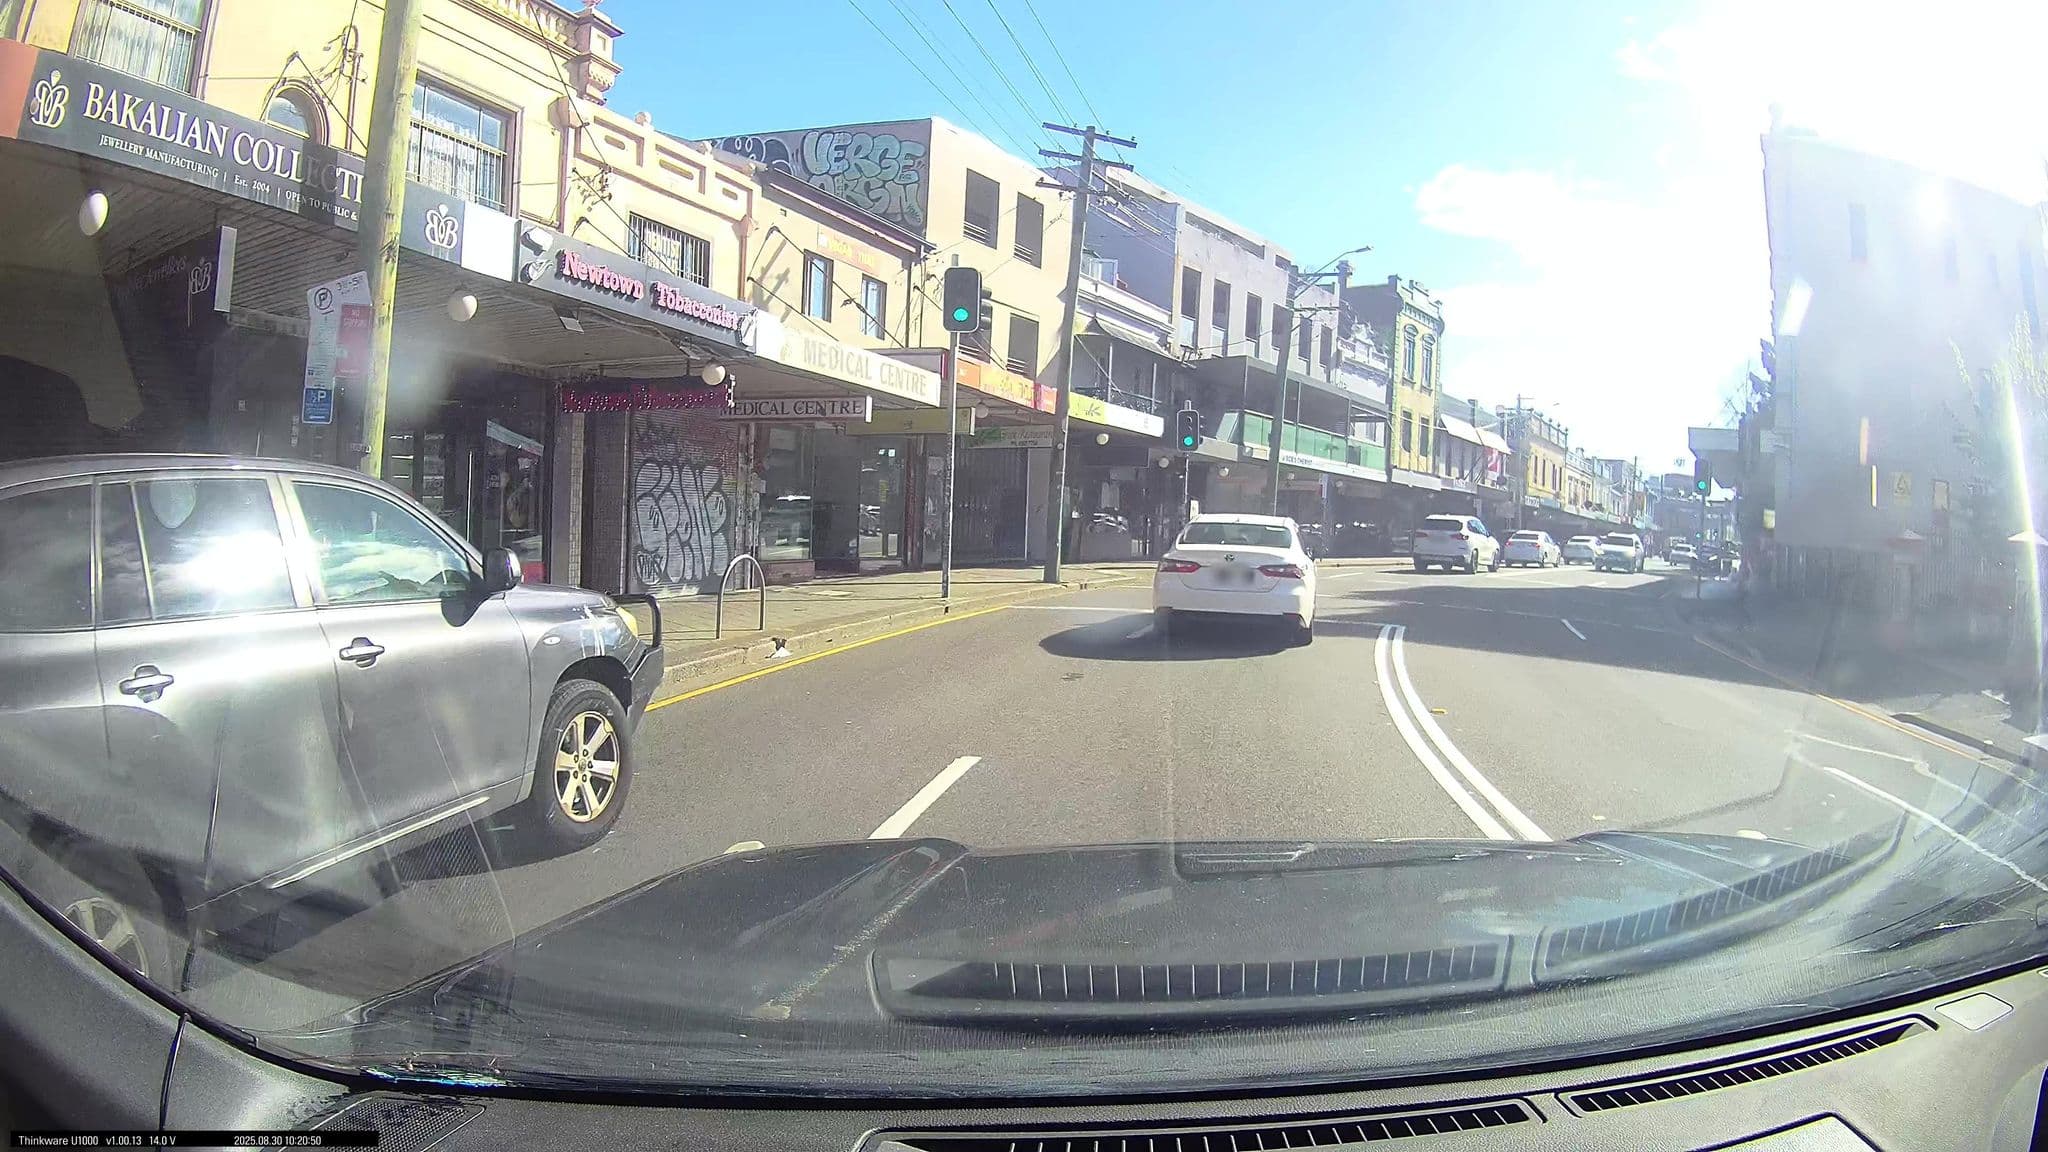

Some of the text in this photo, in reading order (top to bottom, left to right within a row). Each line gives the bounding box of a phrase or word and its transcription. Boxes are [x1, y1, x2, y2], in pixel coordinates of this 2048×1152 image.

[83, 82, 229, 158] BAKALIAN
[99, 134, 219, 178] JEWELLERY MANUFACTURING
[802, 129, 926, 185] VERGE
[252, 181, 270, 193] 2004
[285, 190, 358, 221] OPEN TO PUBLIC &
[562, 250, 645, 300] Newtown
[655, 282, 740, 331] Tobacconist
[803, 337, 927, 397] MEDICAL CENTRE
[793, 400, 863, 416] CENTRE
